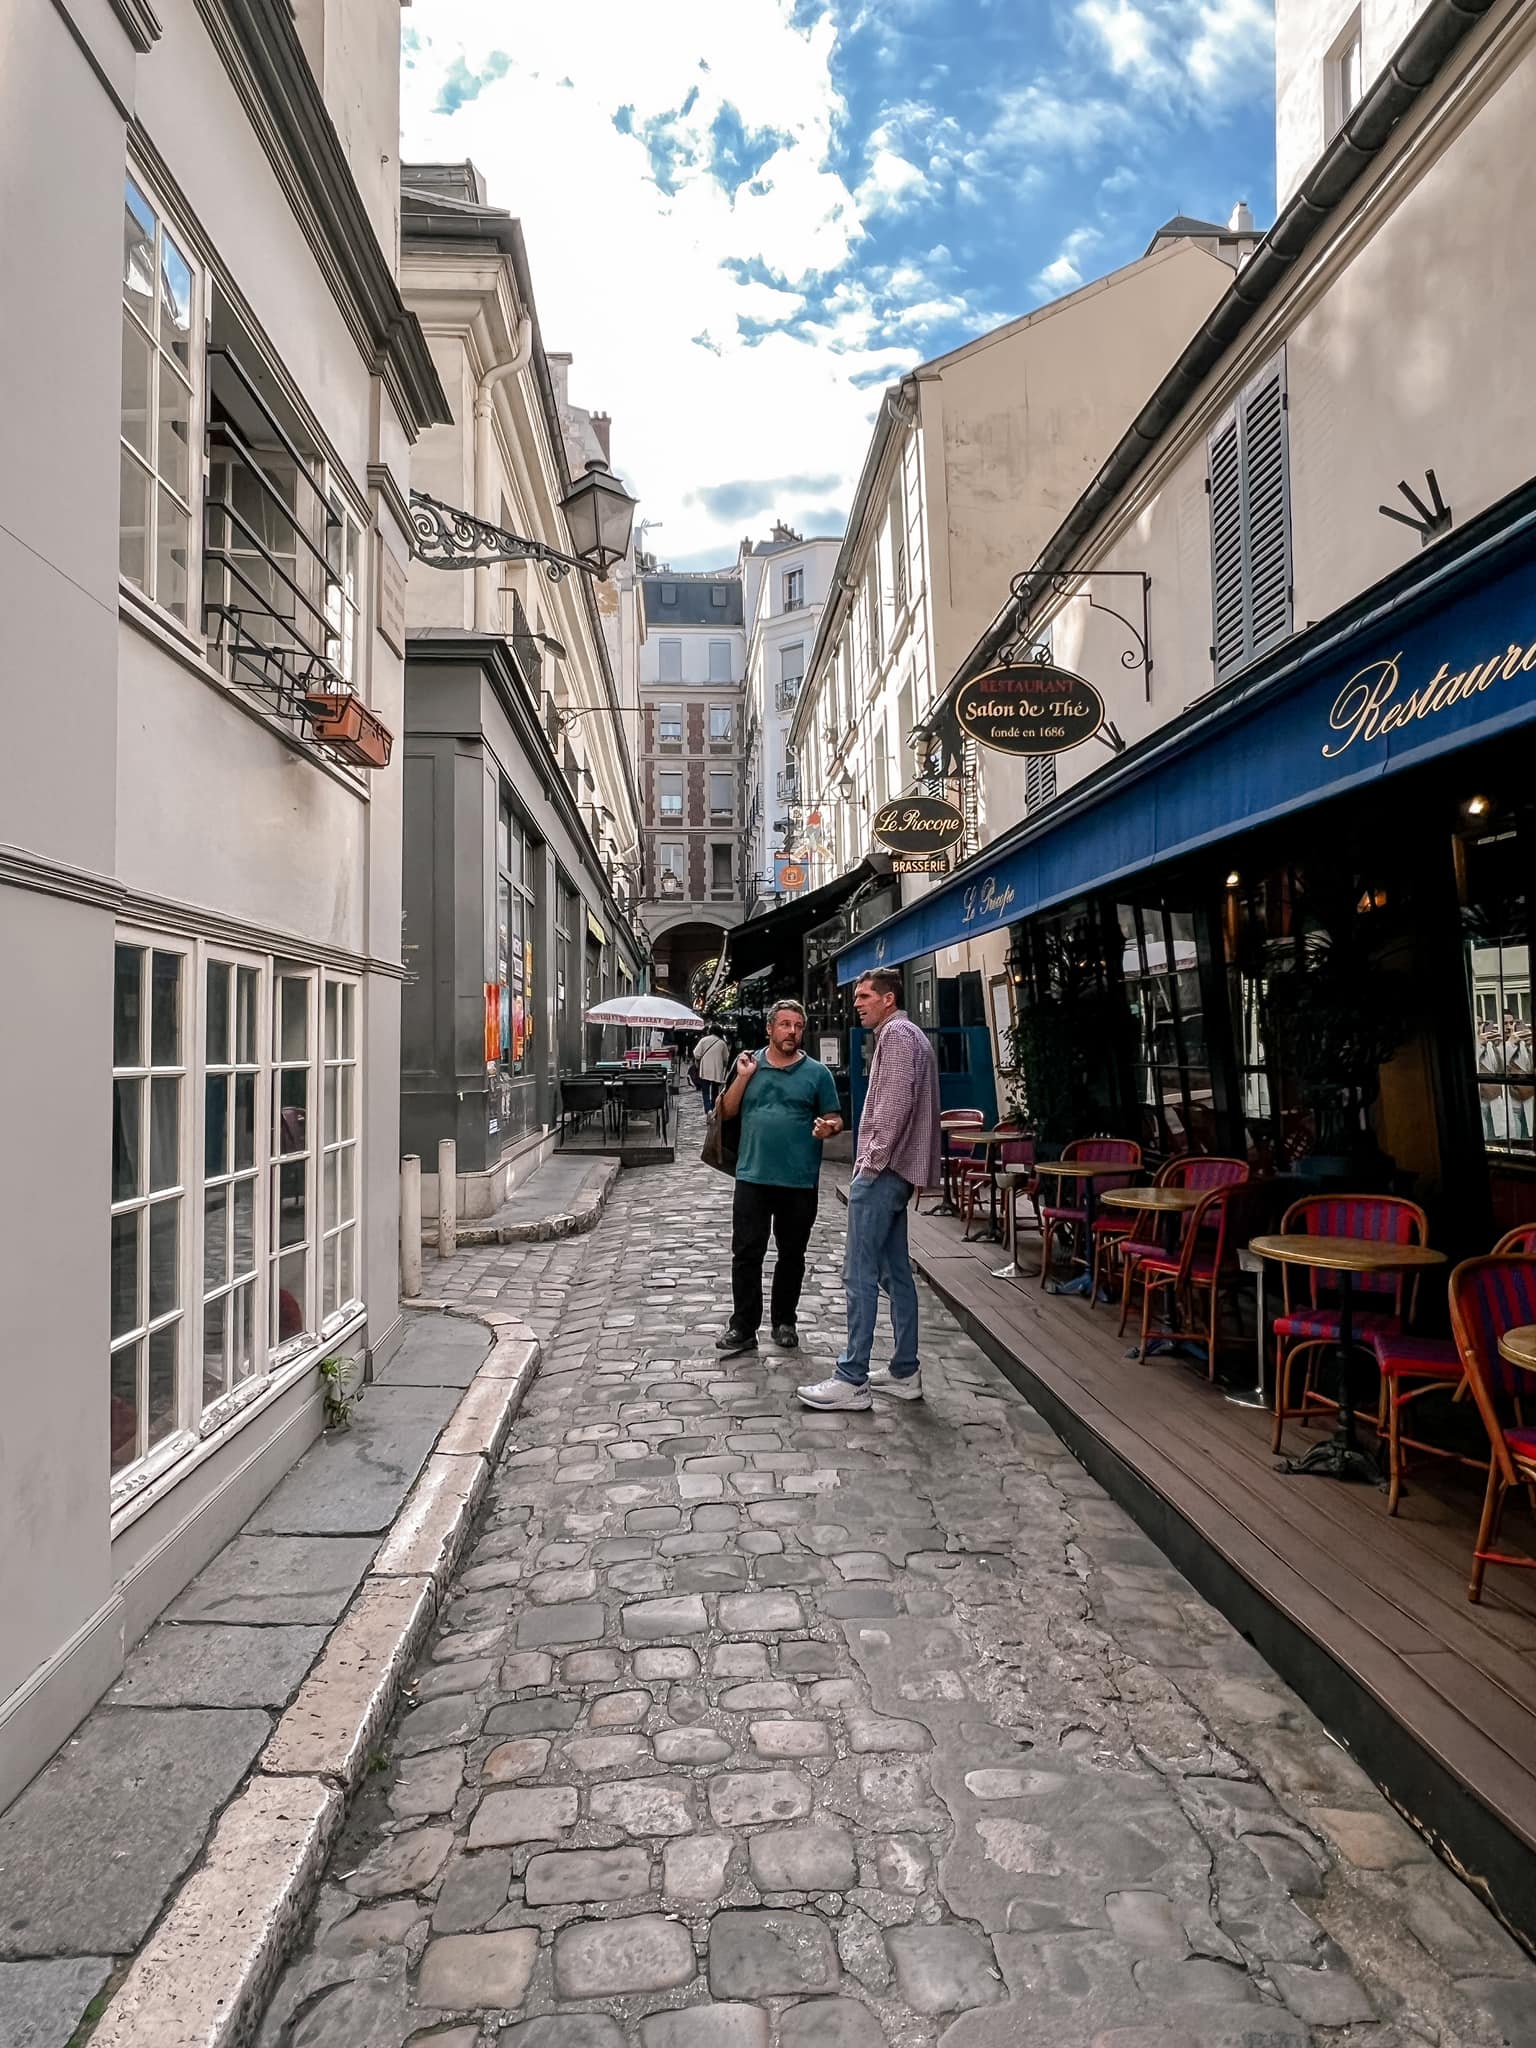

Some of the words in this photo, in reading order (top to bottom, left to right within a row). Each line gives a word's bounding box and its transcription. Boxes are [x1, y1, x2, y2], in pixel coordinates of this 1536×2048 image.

[980, 679, 1073, 693] RESTAURANT
[966, 700, 1014, 720] Salon
[1019, 700, 1044, 717] de
[1049, 700, 1089, 717] Thé
[991, 726, 1020, 738] fondé
[1023, 729, 1035, 737] en
[1040, 726, 1065, 737] 1686
[876, 810, 898, 832] Le
[899, 809, 959, 837] Procope
[892, 860, 946, 872] BRASSERIE
